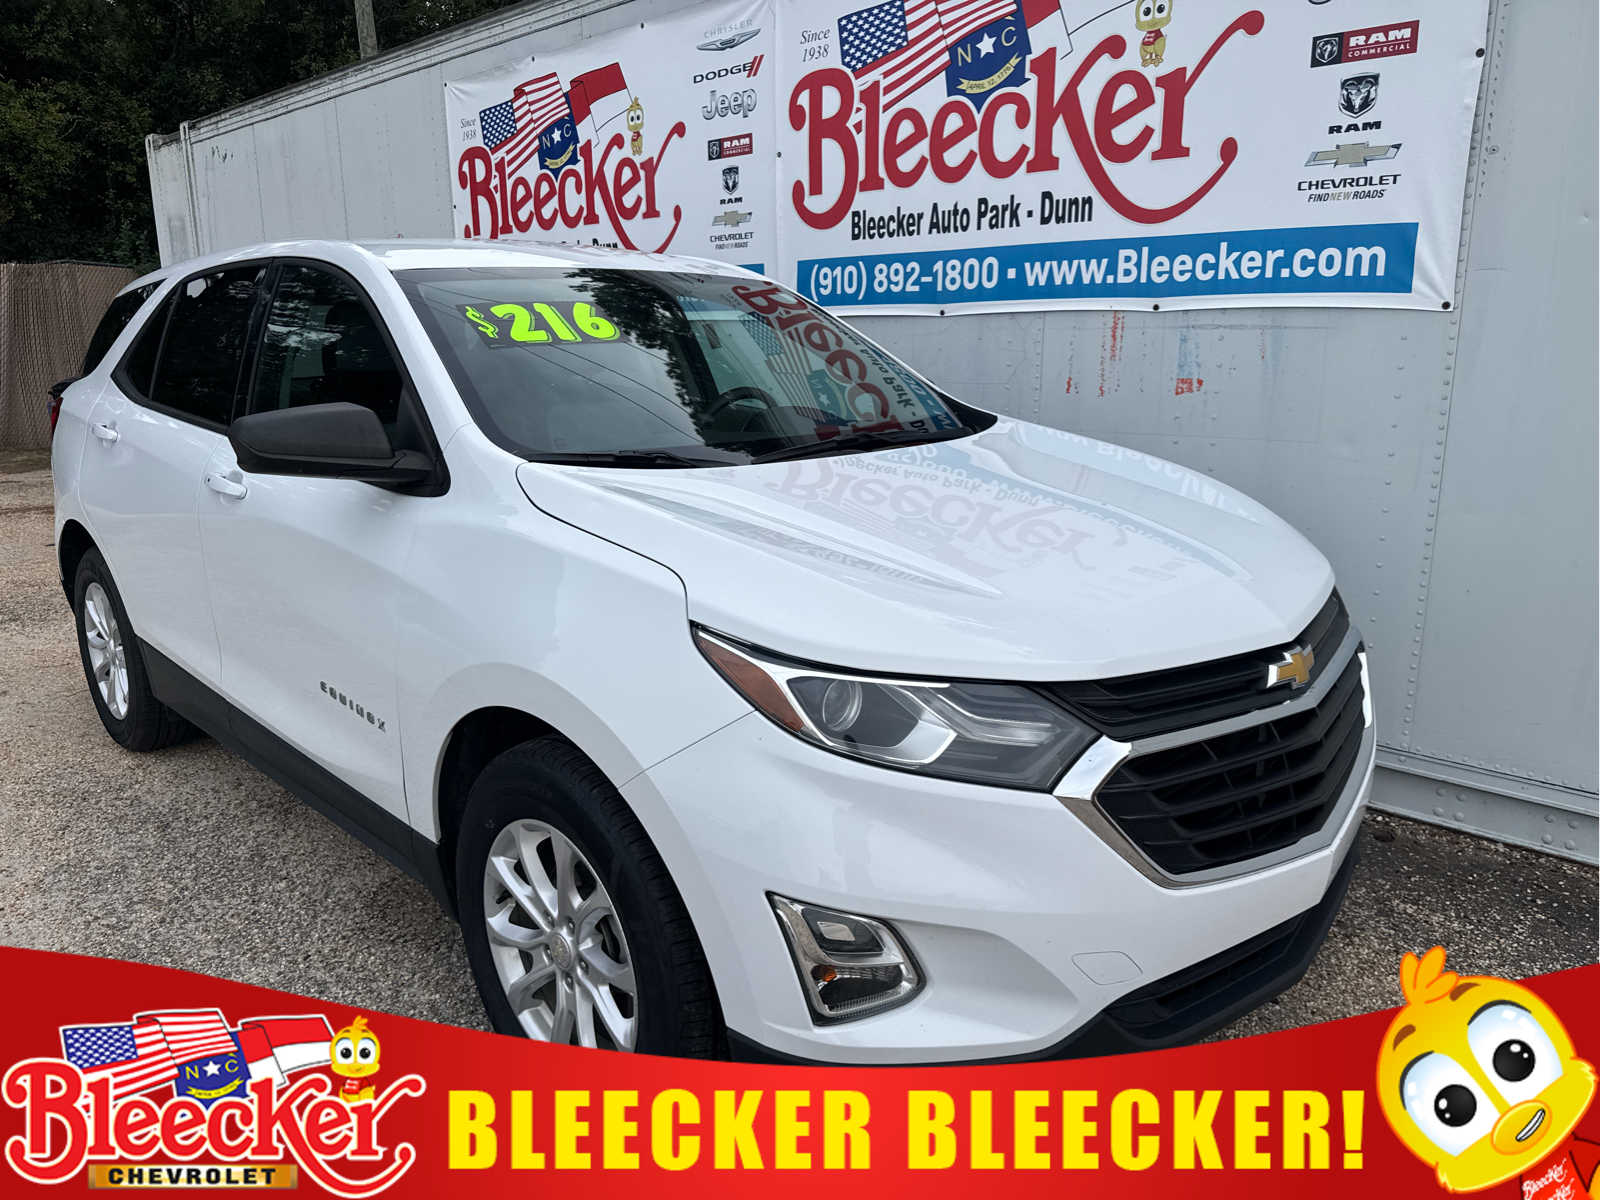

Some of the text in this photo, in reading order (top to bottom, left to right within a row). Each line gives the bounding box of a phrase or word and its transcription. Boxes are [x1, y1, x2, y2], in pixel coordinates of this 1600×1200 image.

[704, 19, 752, 39] CHRYSLER
[800, 29, 830, 44] Since
[1349, 27, 1412, 47] RAM
[802, 44, 829, 62] 1938
[1348, 43, 1411, 58] COMMERCIAL
[693, 61, 753, 84] DODGE
[702, 88, 757, 120] Jeep
[1328, 120, 1382, 135] RAM
[723, 137, 750, 149] RAM
[1297, 174, 1402, 191] CHEVROLET
[720, 196, 743, 205] RAM
[851, 206, 925, 241] Bleecker
[928, 201, 971, 235] Auto
[976, 194, 1021, 231] Park
[1040, 190, 1094, 226] Dunn
[710, 231, 754, 243] CHEVROLET
[809, 263, 868, 303] (910)
[873, 256, 999, 294] 892-1800
[1024, 241, 1386, 289] www.Bleecker.com
[465, 302, 622, 343] $216
[319, 680, 387, 733] EQUINOX
